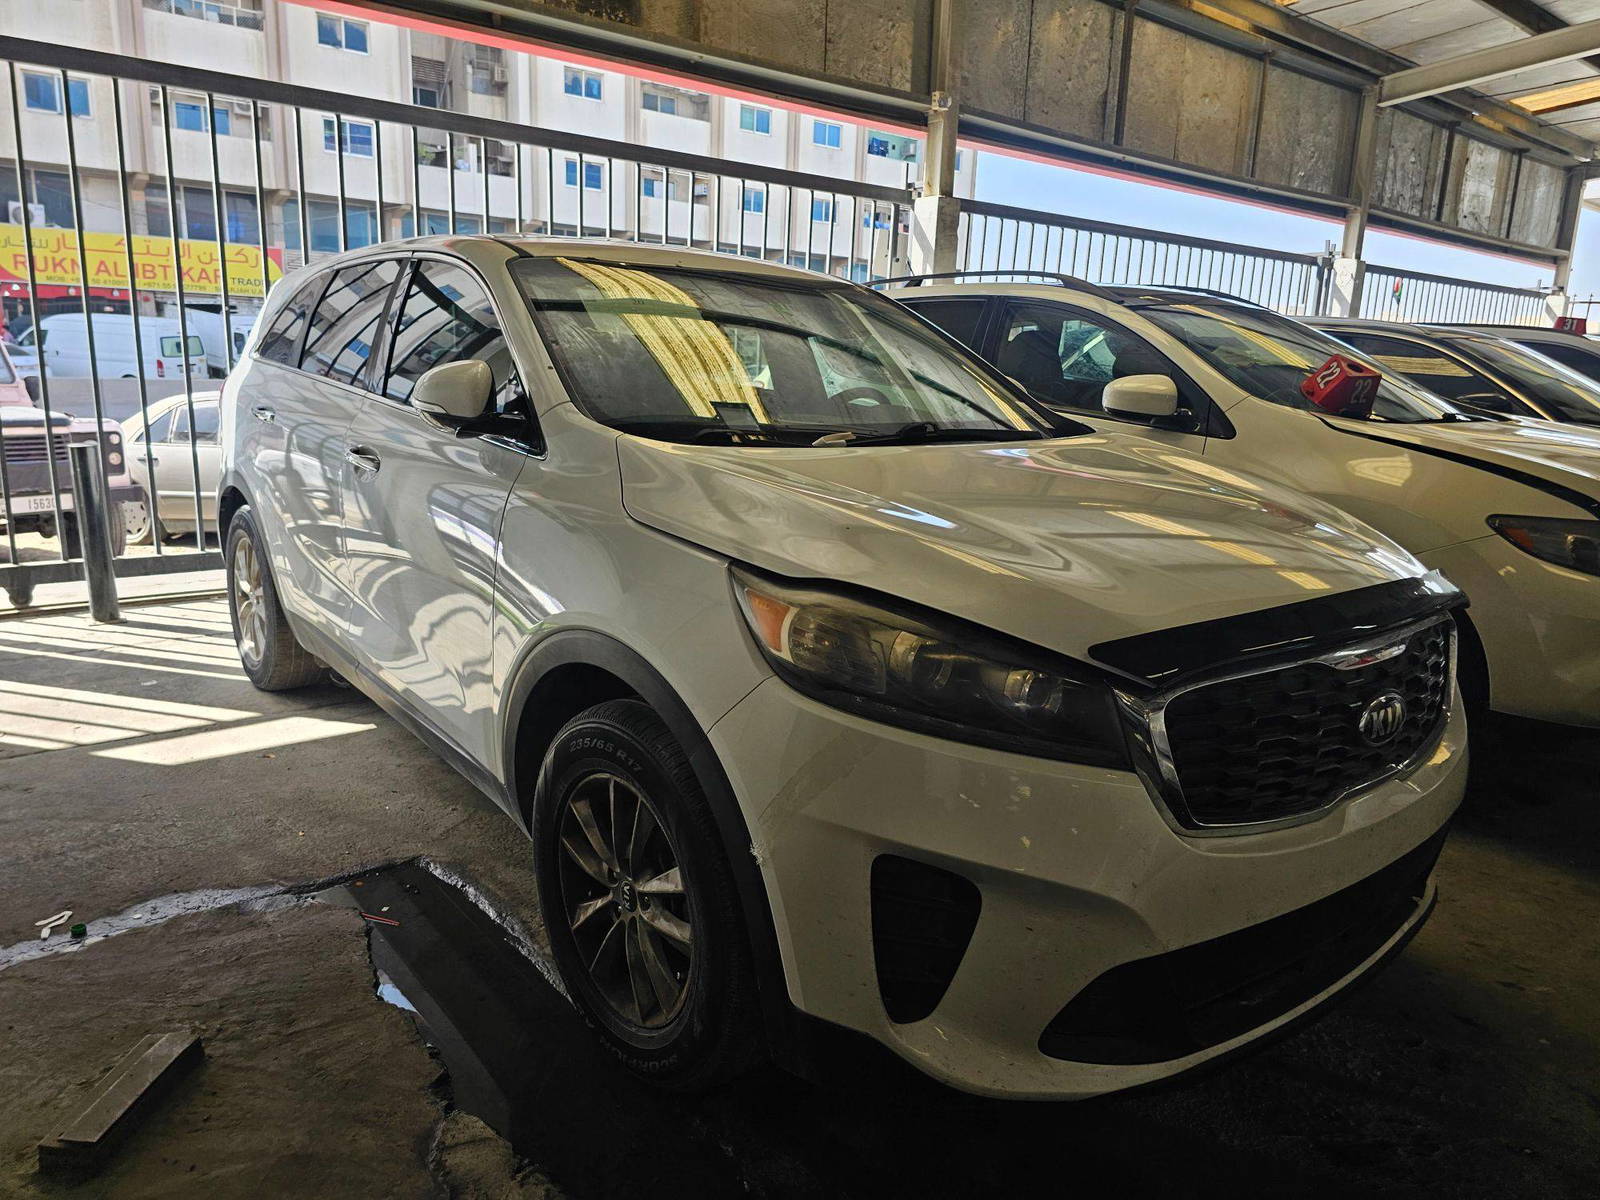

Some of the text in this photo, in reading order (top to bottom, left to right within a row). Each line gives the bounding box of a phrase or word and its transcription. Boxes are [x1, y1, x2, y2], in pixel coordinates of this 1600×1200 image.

[12, 253, 82, 274] RUKN
[1563, 318, 1578, 331] 31
[1316, 361, 1341, 390] 22
[1350, 378, 1372, 404] 22
[1370, 701, 1403, 739] KIA
[569, 737, 643, 771] 235/65 R17
